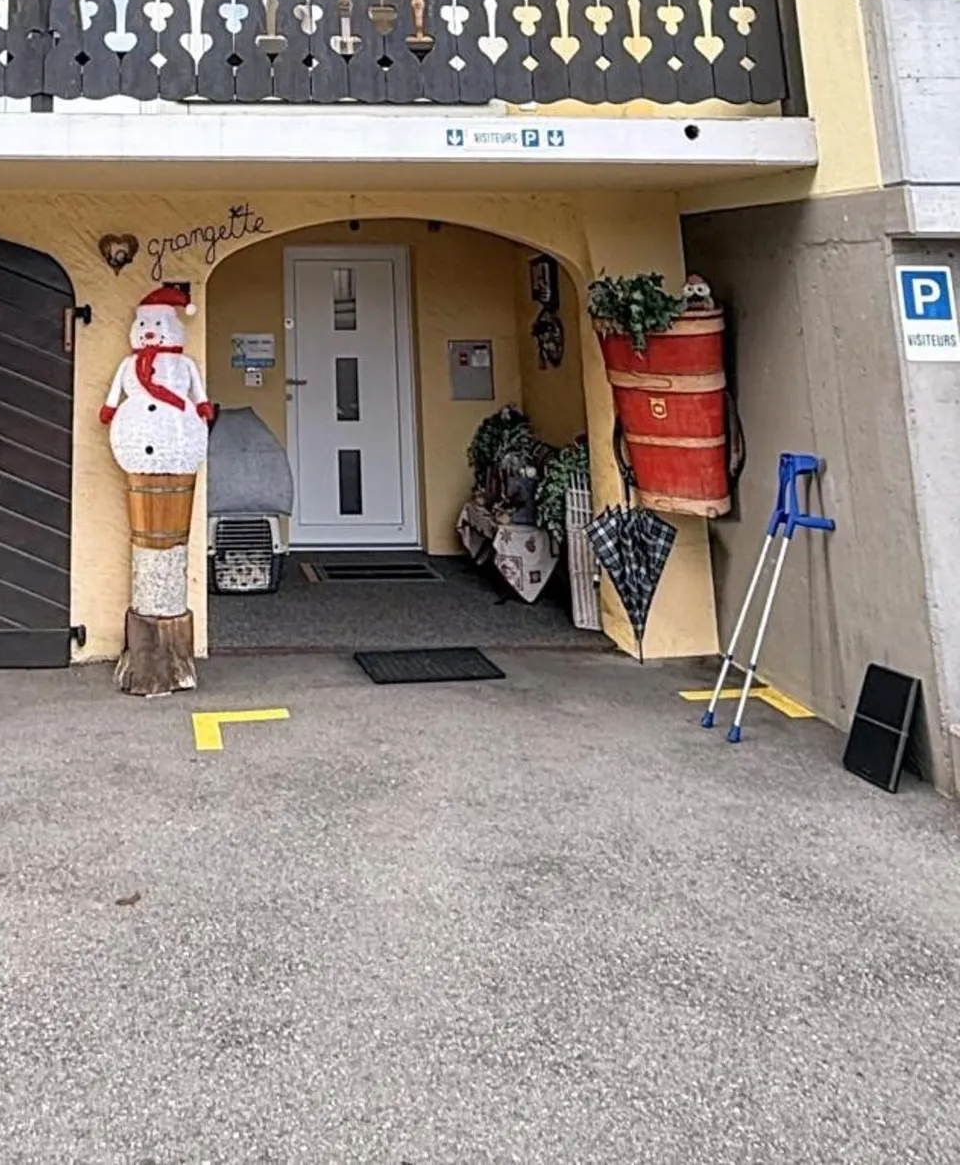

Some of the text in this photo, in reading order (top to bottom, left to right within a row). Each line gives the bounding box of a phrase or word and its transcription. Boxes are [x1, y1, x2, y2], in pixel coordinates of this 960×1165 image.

[473, 132, 518, 143] VISITEURS
[147, 203, 274, 281] grangette
[911, 277, 941, 316] P
[908, 334, 957, 347] VISITEURS
